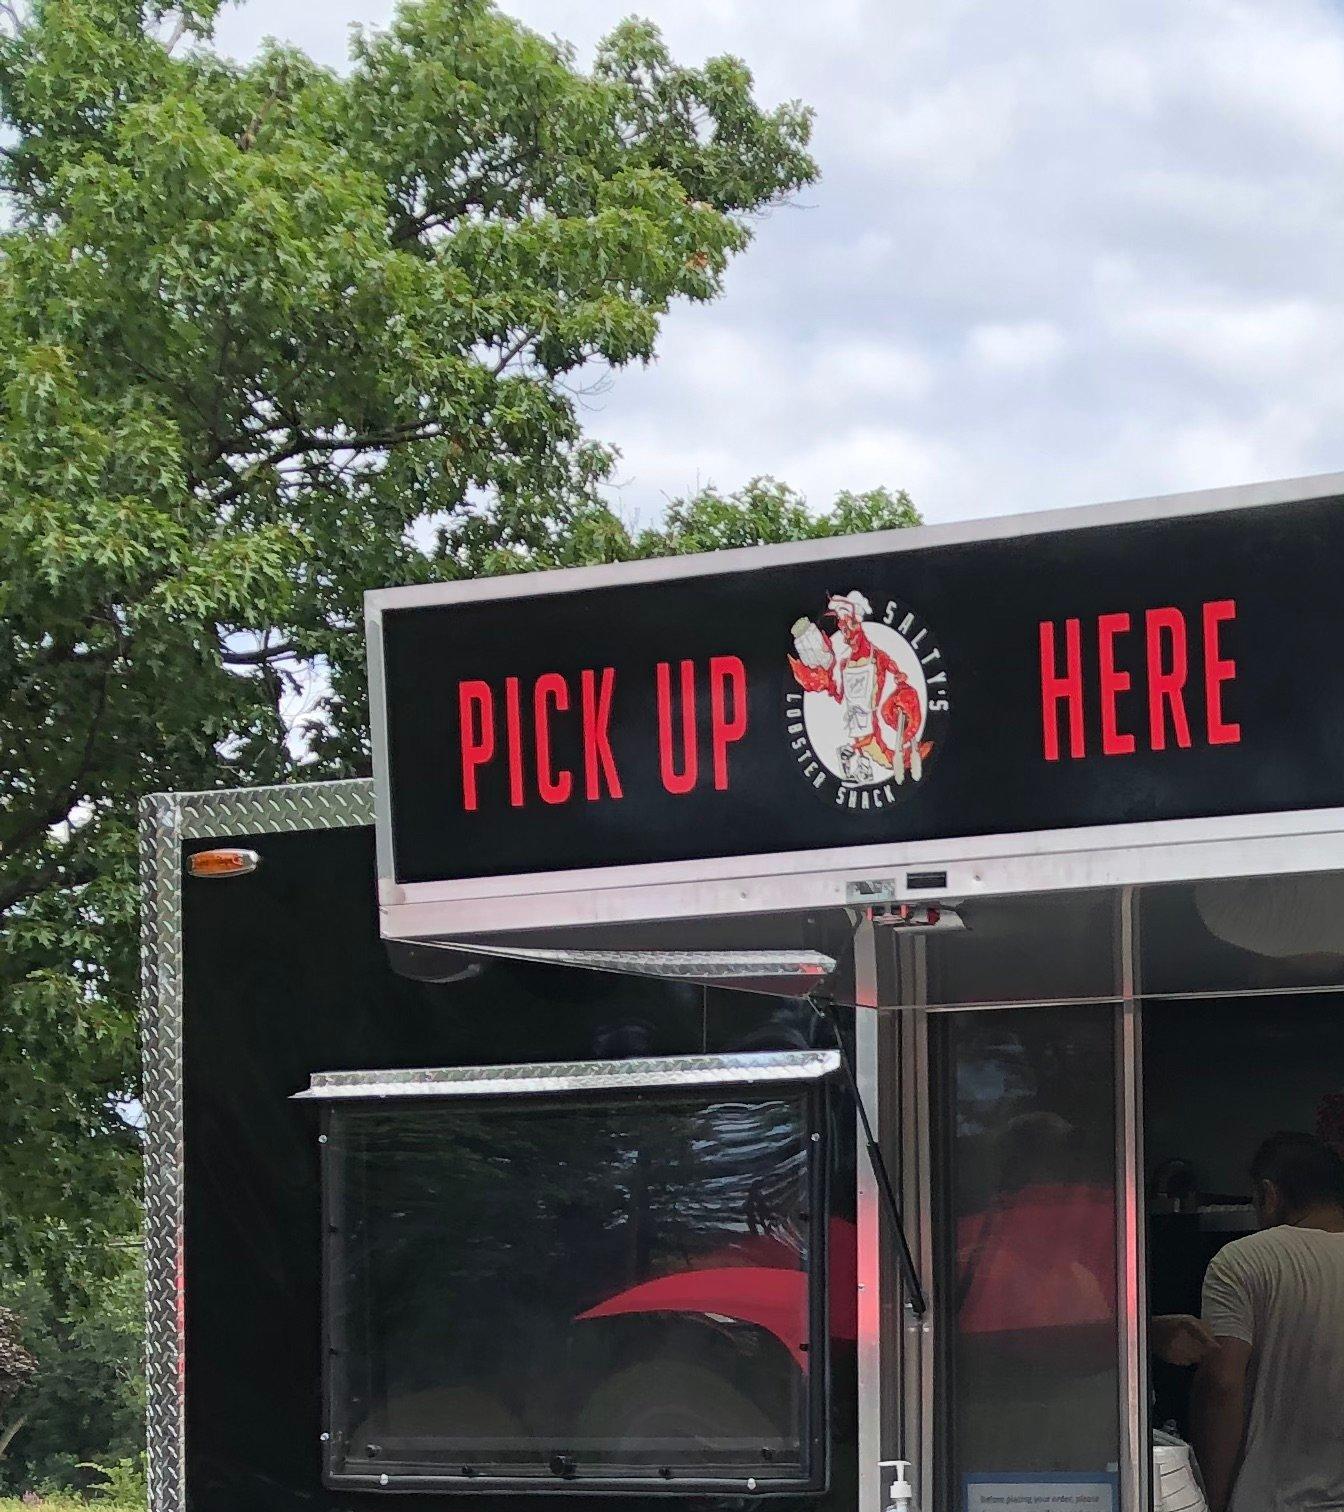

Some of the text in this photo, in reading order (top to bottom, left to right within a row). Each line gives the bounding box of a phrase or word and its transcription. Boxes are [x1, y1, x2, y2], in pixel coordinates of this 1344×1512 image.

[459, 600, 1240, 810] PICK UP HERE
[883, 600, 950, 711] SALTY'S
[785, 692, 896, 810] LOBSTER SHACK
